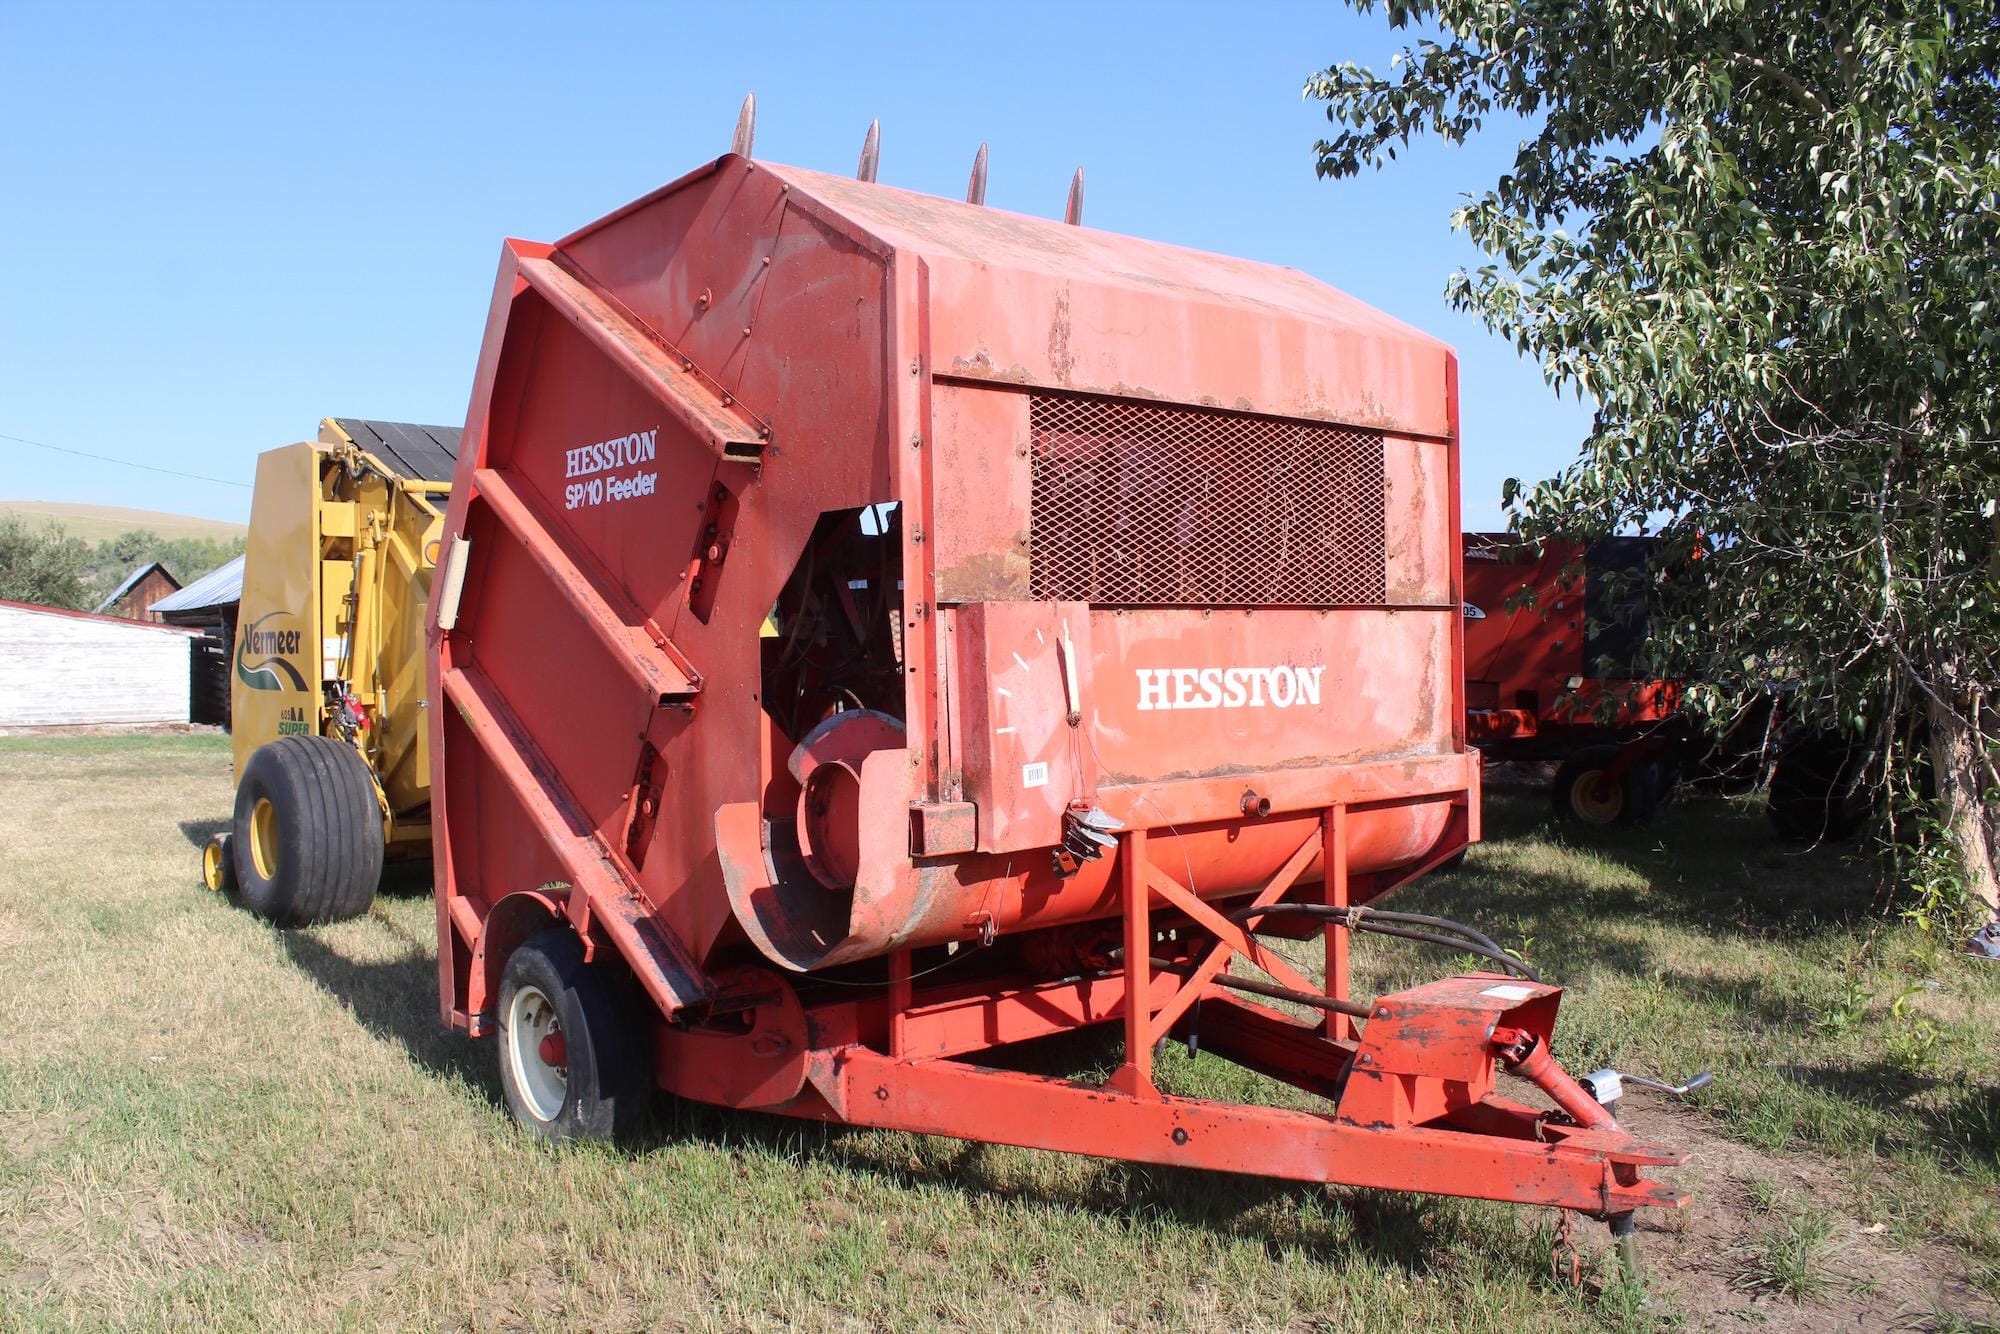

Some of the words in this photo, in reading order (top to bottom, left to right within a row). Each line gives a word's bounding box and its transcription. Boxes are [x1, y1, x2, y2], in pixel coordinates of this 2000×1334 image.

[566, 429, 657, 478] HESSTON
[565, 478, 603, 510] SP/10
[606, 470, 657, 502] Feeder
[244, 623, 301, 655] Vermeer
[1135, 665, 1323, 711] HESSTON
[278, 721, 309, 736] SUPER
